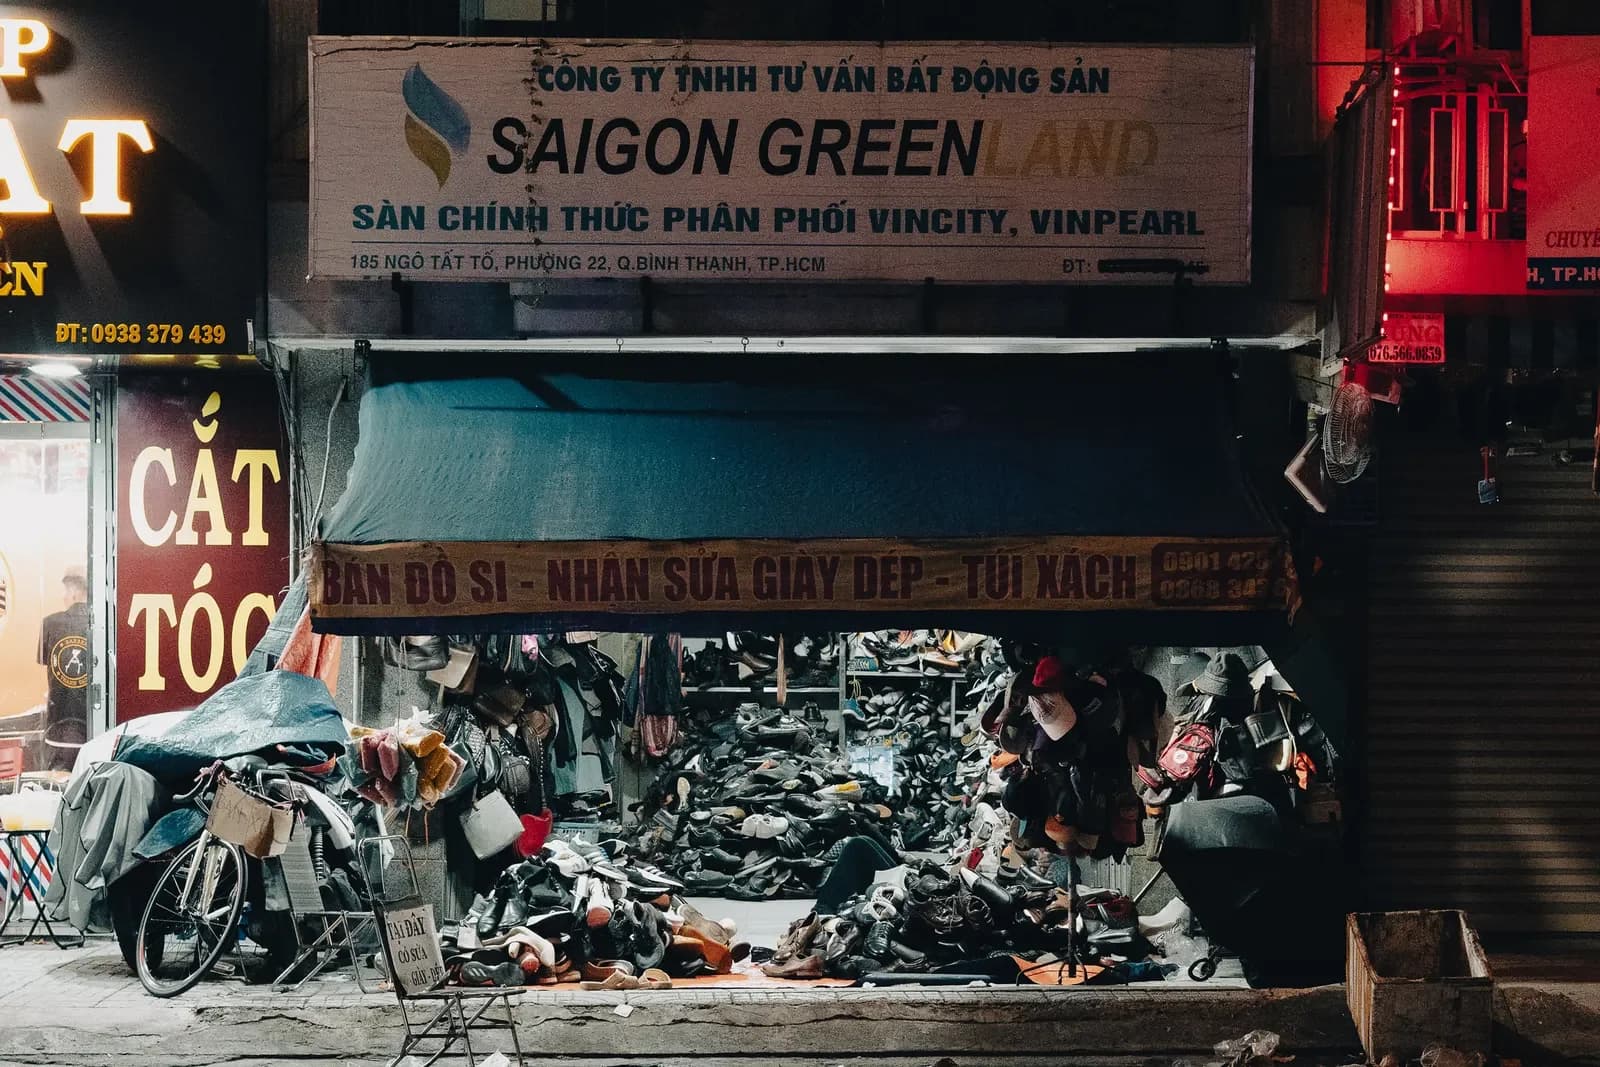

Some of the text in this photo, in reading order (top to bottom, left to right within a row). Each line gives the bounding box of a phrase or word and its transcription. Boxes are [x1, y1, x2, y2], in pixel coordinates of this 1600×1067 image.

[537, 54, 1110, 99] CÔNG TY TNHH TƯ VẤN BẤT ĐỘNG SẢN
[486, 116, 739, 176] SAIGON
[352, 199, 1205, 239] SÀN CHÍNH THỨC PHÂN PHỐI VINCITY, VINPEARL
[351, 255, 379, 270] 185
[384, 251, 425, 270] NGÔ
[431, 249, 465, 270] TẤT
[587, 256, 612, 272] 22,
[758, 256, 825, 272] TP.HCM
[147, 325, 184, 344] 379
[189, 325, 226, 344] 439
[129, 391, 281, 548] CẮT
[470, 559, 508, 605] SI
